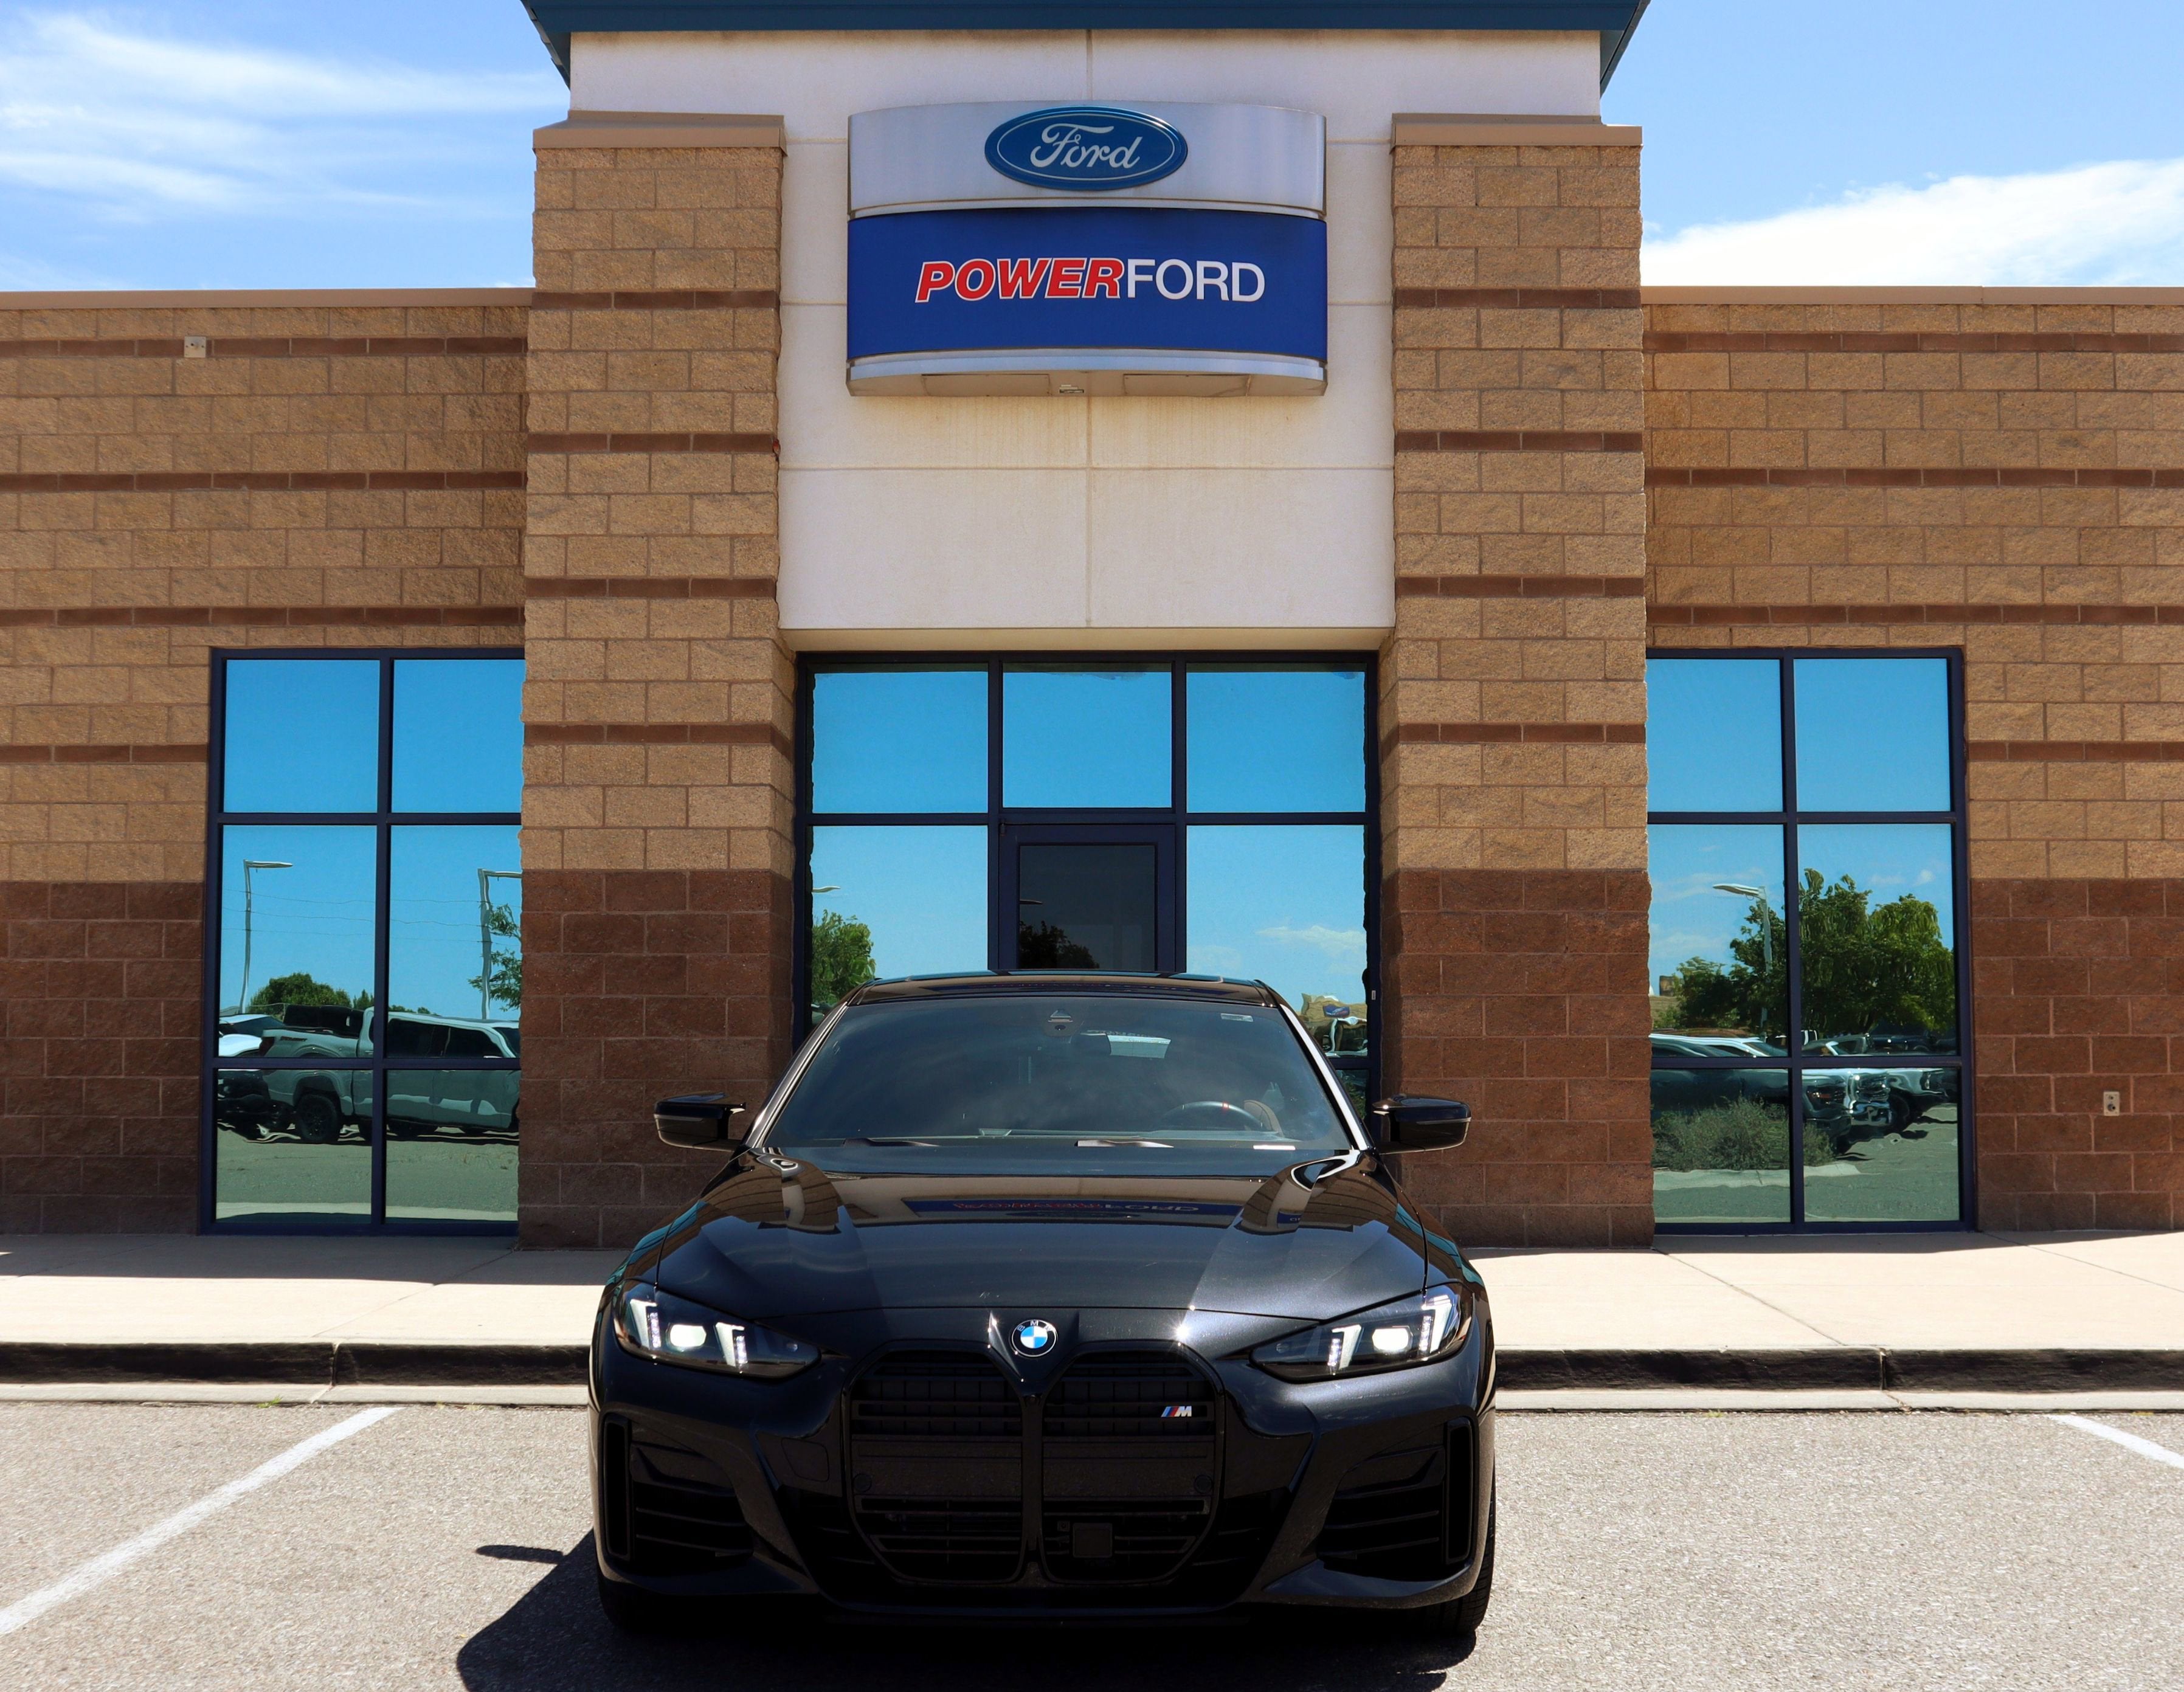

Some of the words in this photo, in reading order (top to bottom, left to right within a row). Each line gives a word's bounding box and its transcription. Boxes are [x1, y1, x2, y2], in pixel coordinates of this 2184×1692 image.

[1030, 123, 1142, 168] Ford
[914, 257, 1265, 303] POWERFORD
[1017, 1319, 1054, 1332] BMW
[1173, 1406, 1192, 1417] M
